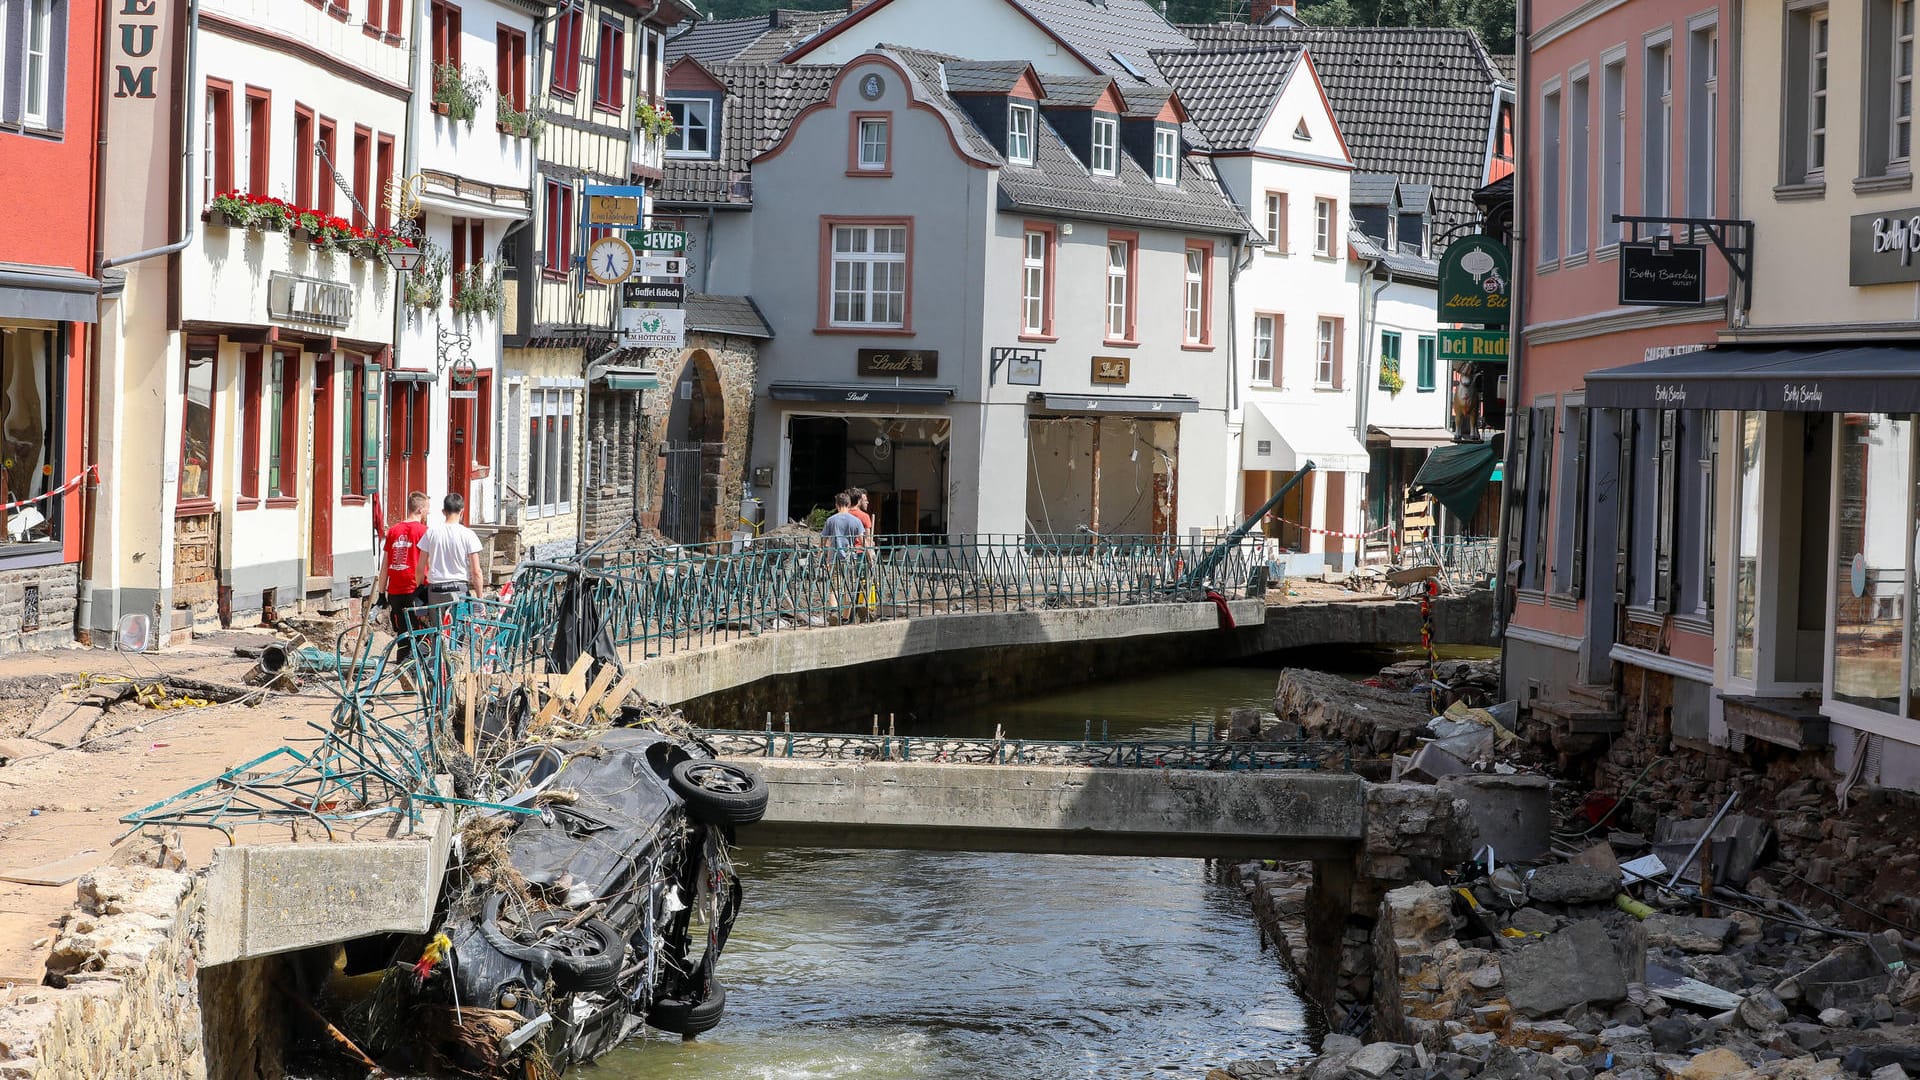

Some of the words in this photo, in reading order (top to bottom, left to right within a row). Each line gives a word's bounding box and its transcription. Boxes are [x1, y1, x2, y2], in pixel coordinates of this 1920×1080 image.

[643, 232, 683, 249] JEVER
[1872, 217, 1907, 267] Betty
[1628, 267, 1656, 282] Betty
[1658, 268, 1697, 283] Barclay
[635, 287, 655, 297] Gaffel
[656, 288, 680, 298] Kölsch
[1445, 293, 1481, 308] Little
[1486, 293, 1508, 308] Bit
[1442, 335, 1467, 354] bei
[1472, 336, 1510, 356] Rudi
[868, 354, 911, 371] Lindt
[845, 391, 869, 402] Lindt
[1655, 385, 1668, 408] Betty
[1668, 384, 1687, 408] Barclay
[1783, 384, 1800, 409] Betty
[1800, 383, 1823, 409] Barclay
